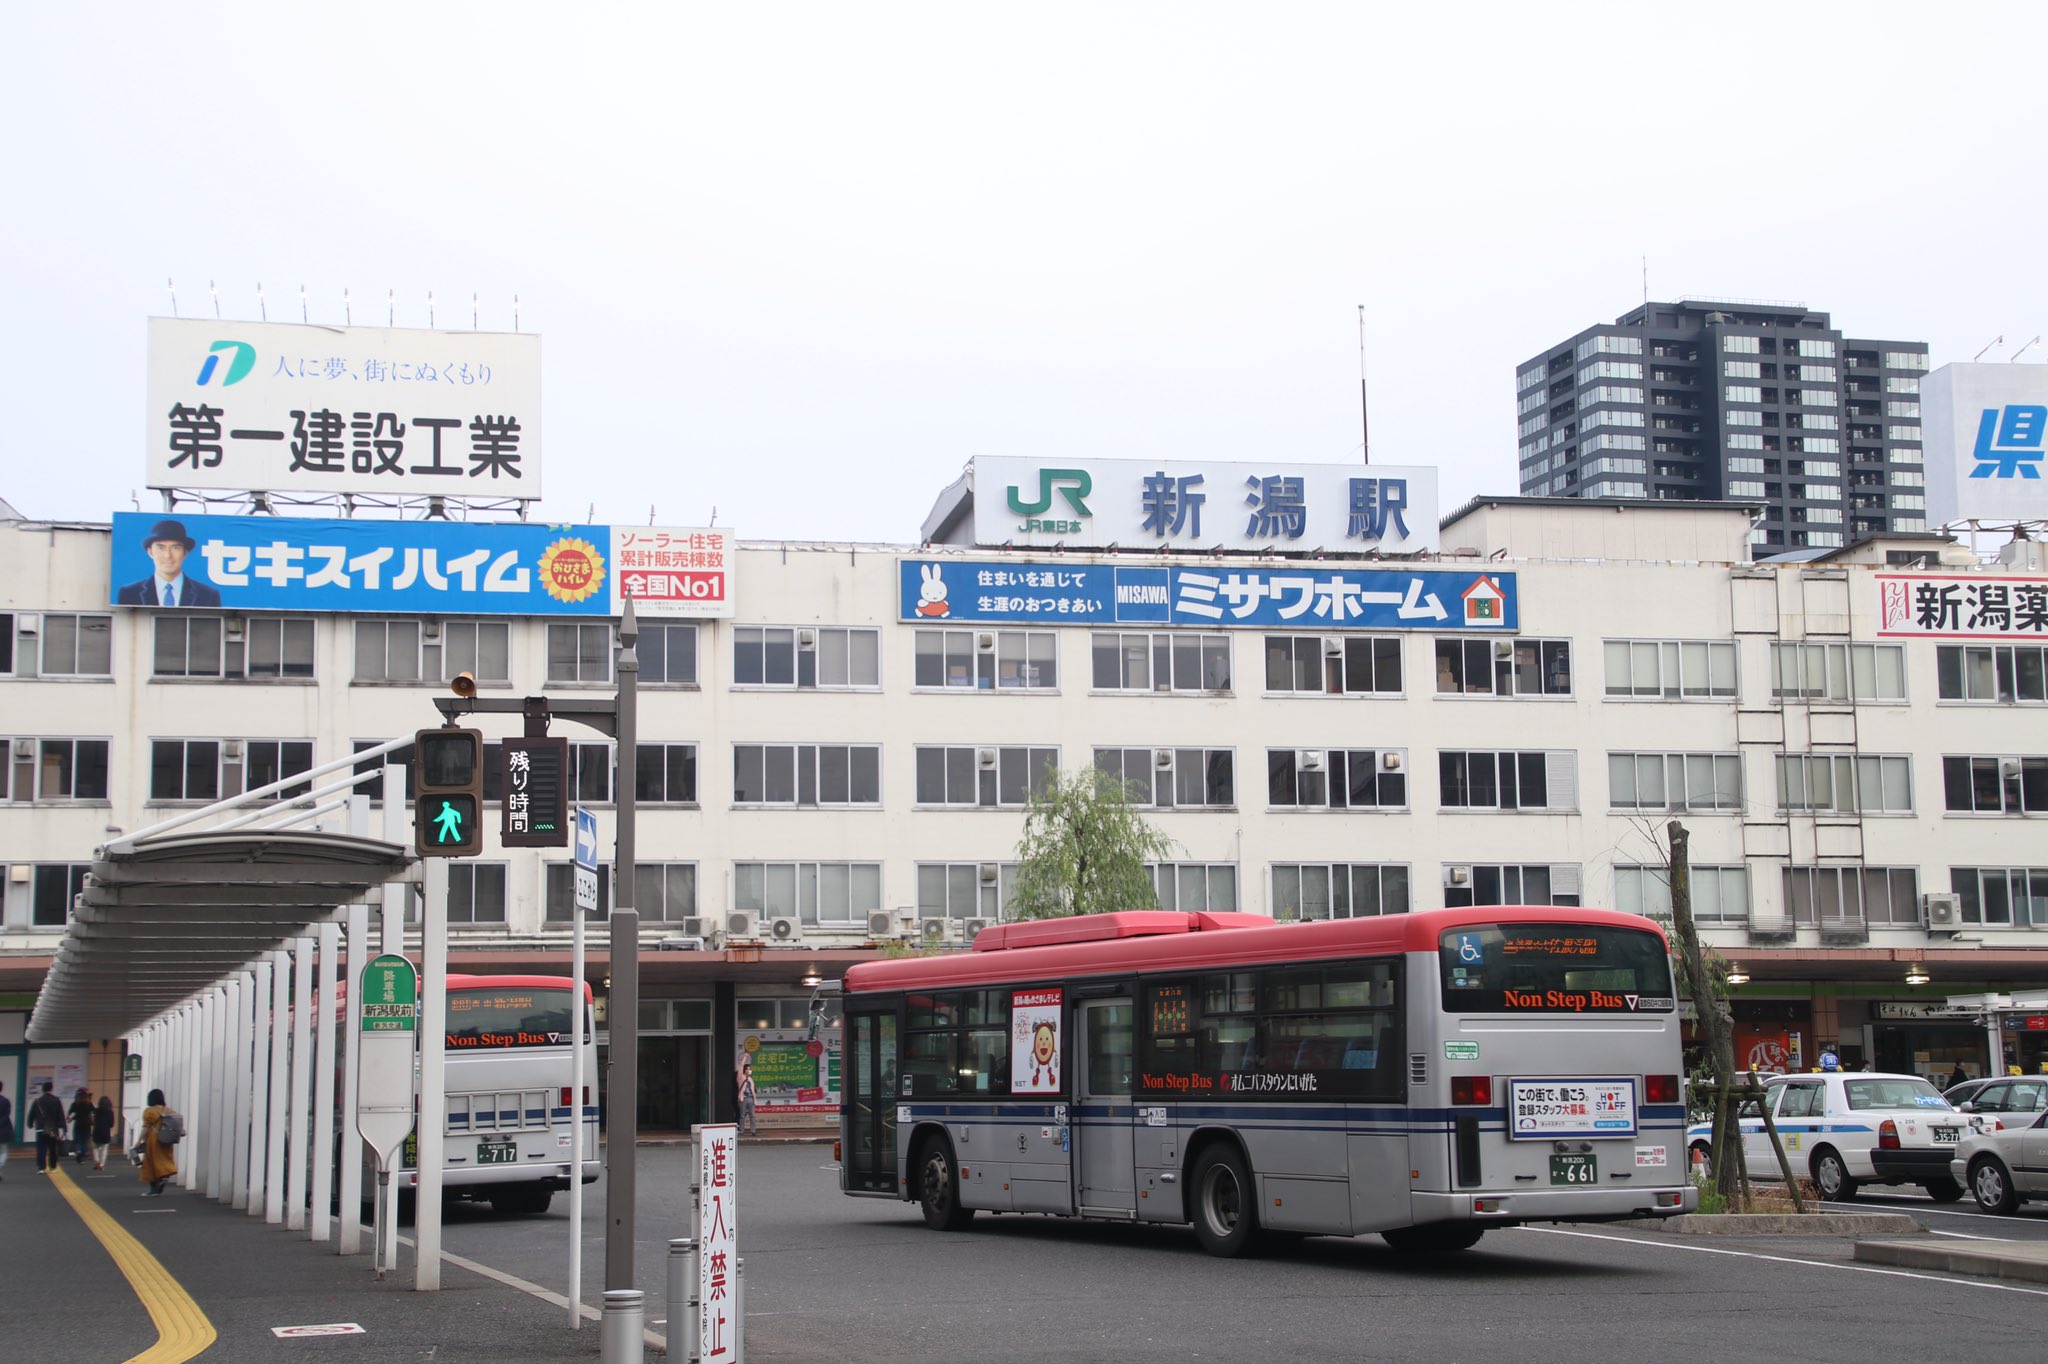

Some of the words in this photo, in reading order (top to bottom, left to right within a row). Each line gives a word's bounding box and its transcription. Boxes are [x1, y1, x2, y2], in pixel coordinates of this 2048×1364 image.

[273, 355, 492, 386] 人に夢、街にぬくもり
[168, 402, 522, 480] 第一建設工業
[1969, 404, 2048, 480] 県
[1006, 468, 1093, 517] JR
[1141, 470, 1412, 542] 新潟駅
[1018, 518, 1082, 534] JR東日本
[621, 533, 723, 551] ソーラー住宅
[201, 539, 531, 593] セキスイハイム
[553, 562, 591, 575] おひさま
[620, 550, 724, 569] 累計販売棟数
[557, 573, 585, 585] ハイム
[623, 573, 720, 598] 全国No1
[977, 570, 1087, 588] 住まいを通じて
[977, 596, 1103, 613] 生涯のおつきあい
[1117, 585, 1169, 605] MISAWA
[1175, 571, 1449, 622] ミサワホーム
[1916, 582, 2048, 633] 新潟薬
[509, 750, 530, 833] 残り時間
[578, 877, 596, 903] ここから
[365, 1004, 412, 1017] 新潟駅前
[1503, 990, 1543, 1008] Non
[1546, 990, 1586, 1012] Step
[1590, 991, 1623, 1008] Bus
[447, 1034, 478, 1047] Non
[481, 1032, 514, 1048] Step
[517, 1032, 545, 1045] Bus
[757, 1053, 808, 1064] 住宅ローン
[1142, 1073, 1164, 1089] Non
[1166, 1072, 1189, 1092] Step
[1191, 1073, 1213, 1089] Bus
[1230, 1072, 1318, 1092] オムニバスタウンにいがた
[1518, 1087, 1590, 1102] この街で、働こう。
[1600, 1092, 1621, 1101] HOT
[1518, 1103, 1590, 1116] 登録スタッフ大募集。
[1595, 1101, 1627, 1111] STAFF
[710, 1137, 727, 1358] 進入禁止
